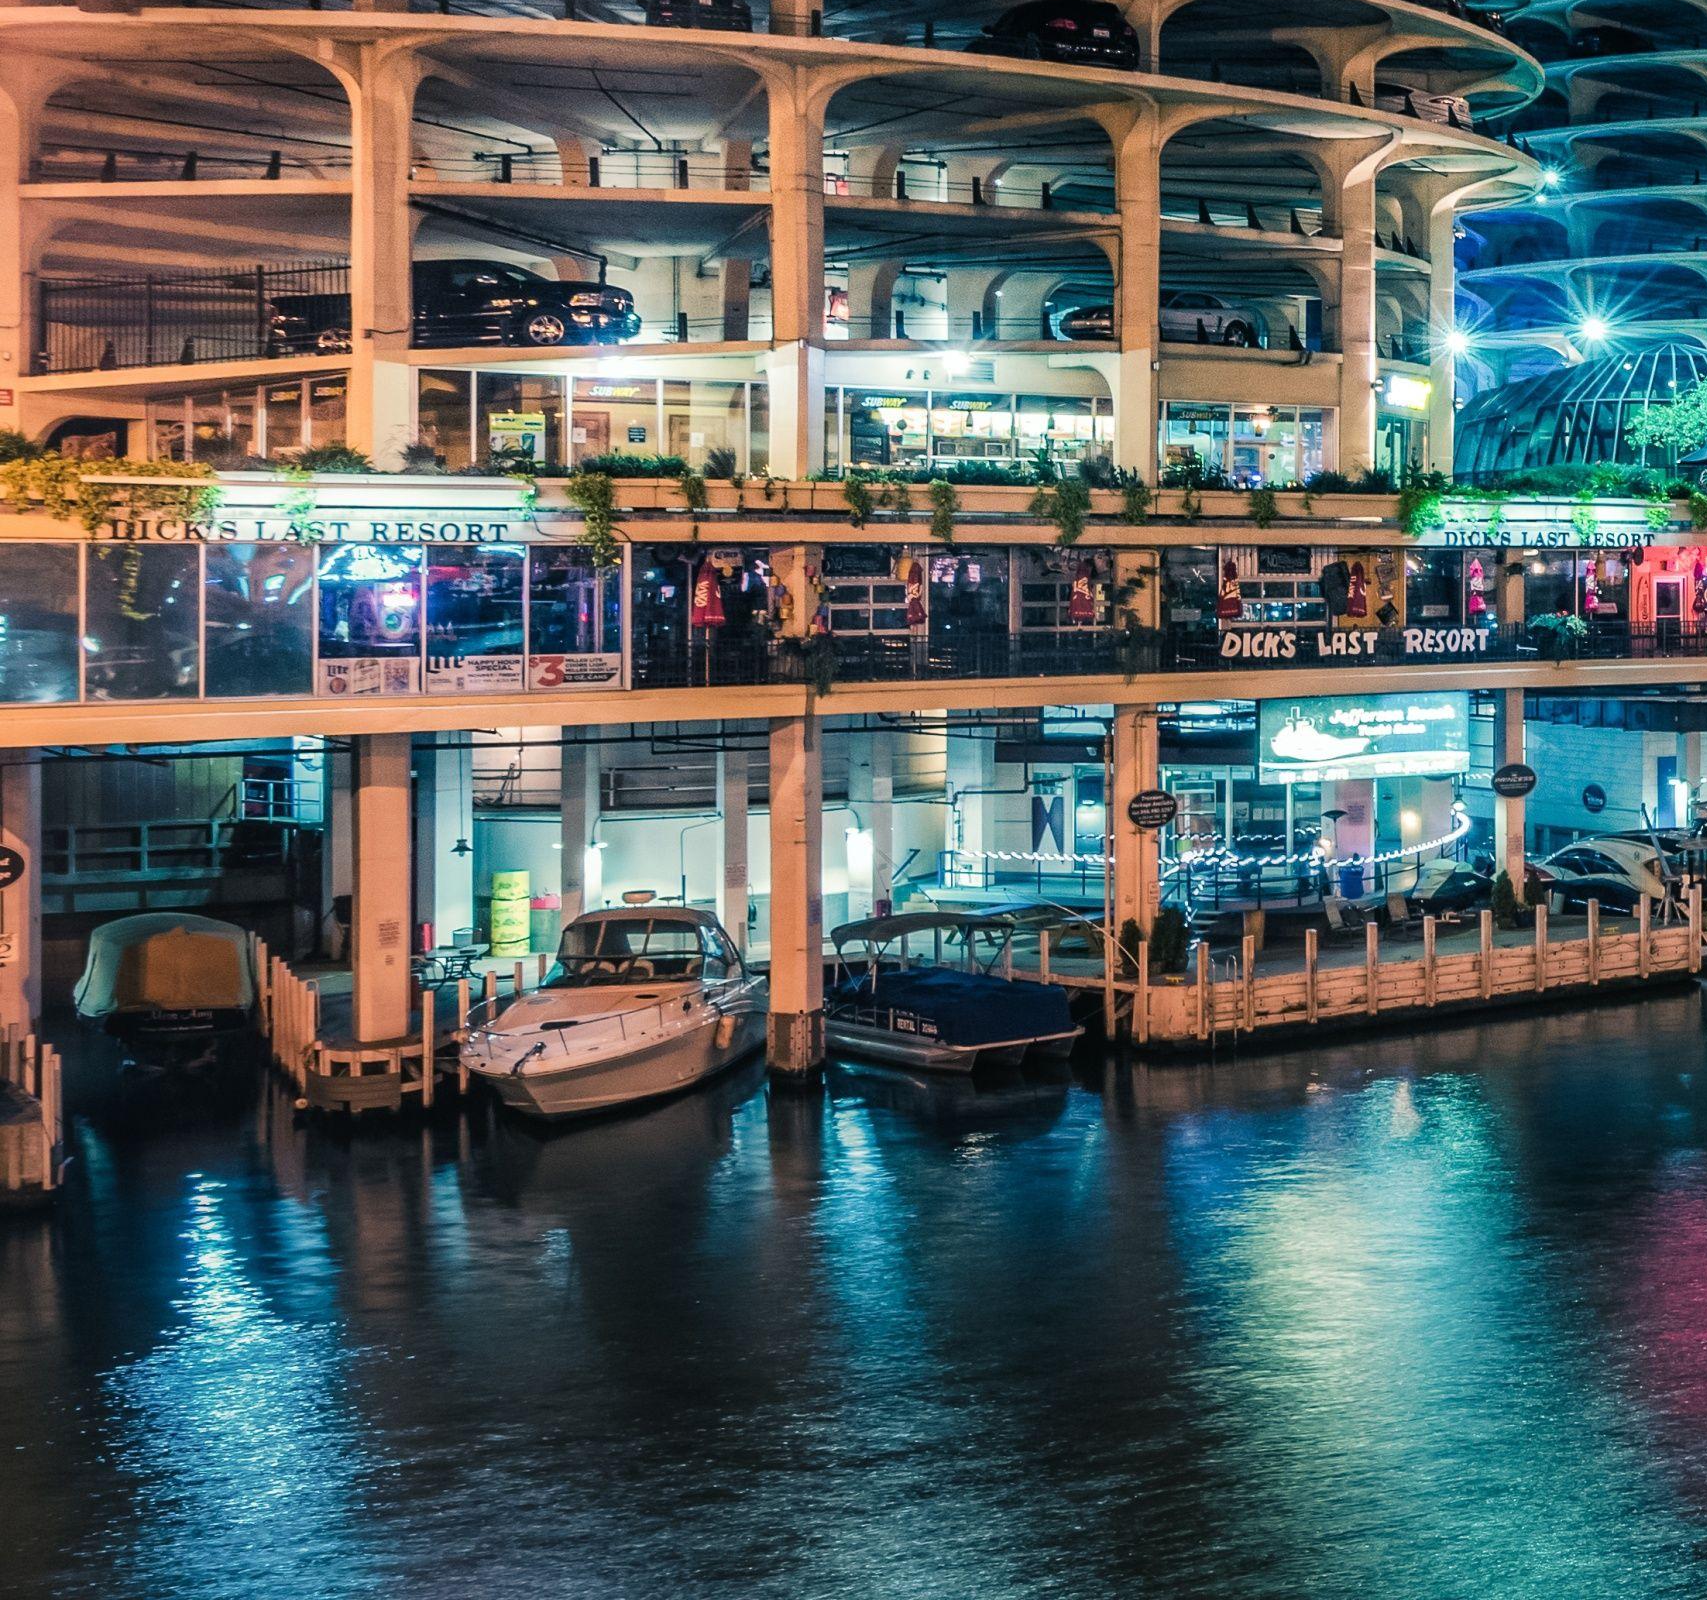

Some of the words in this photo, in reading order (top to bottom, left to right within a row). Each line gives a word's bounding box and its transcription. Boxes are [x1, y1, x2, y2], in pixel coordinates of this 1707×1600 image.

[589, 385, 641, 397] SUBWAY
[861, 396, 908, 408] SUBWAY
[949, 399, 993, 411] SUBWAY
[1177, 410, 1214, 420] SUBWAY
[110, 518, 238, 542] DICK'S
[257, 520, 350, 542] LAST
[371, 522, 509, 543] RESORT
[1444, 531, 1512, 547] DICK'S
[1521, 532, 1570, 547] LAST
[1220, 631, 1297, 658] DICK'S
[1317, 631, 1379, 657] LAST
[1402, 628, 1490, 654] RESORT
[475, 664, 513, 672] SPECIAL
[528, 656, 565, 687] $3
[1494, 775, 1535, 783] PRINCESS
